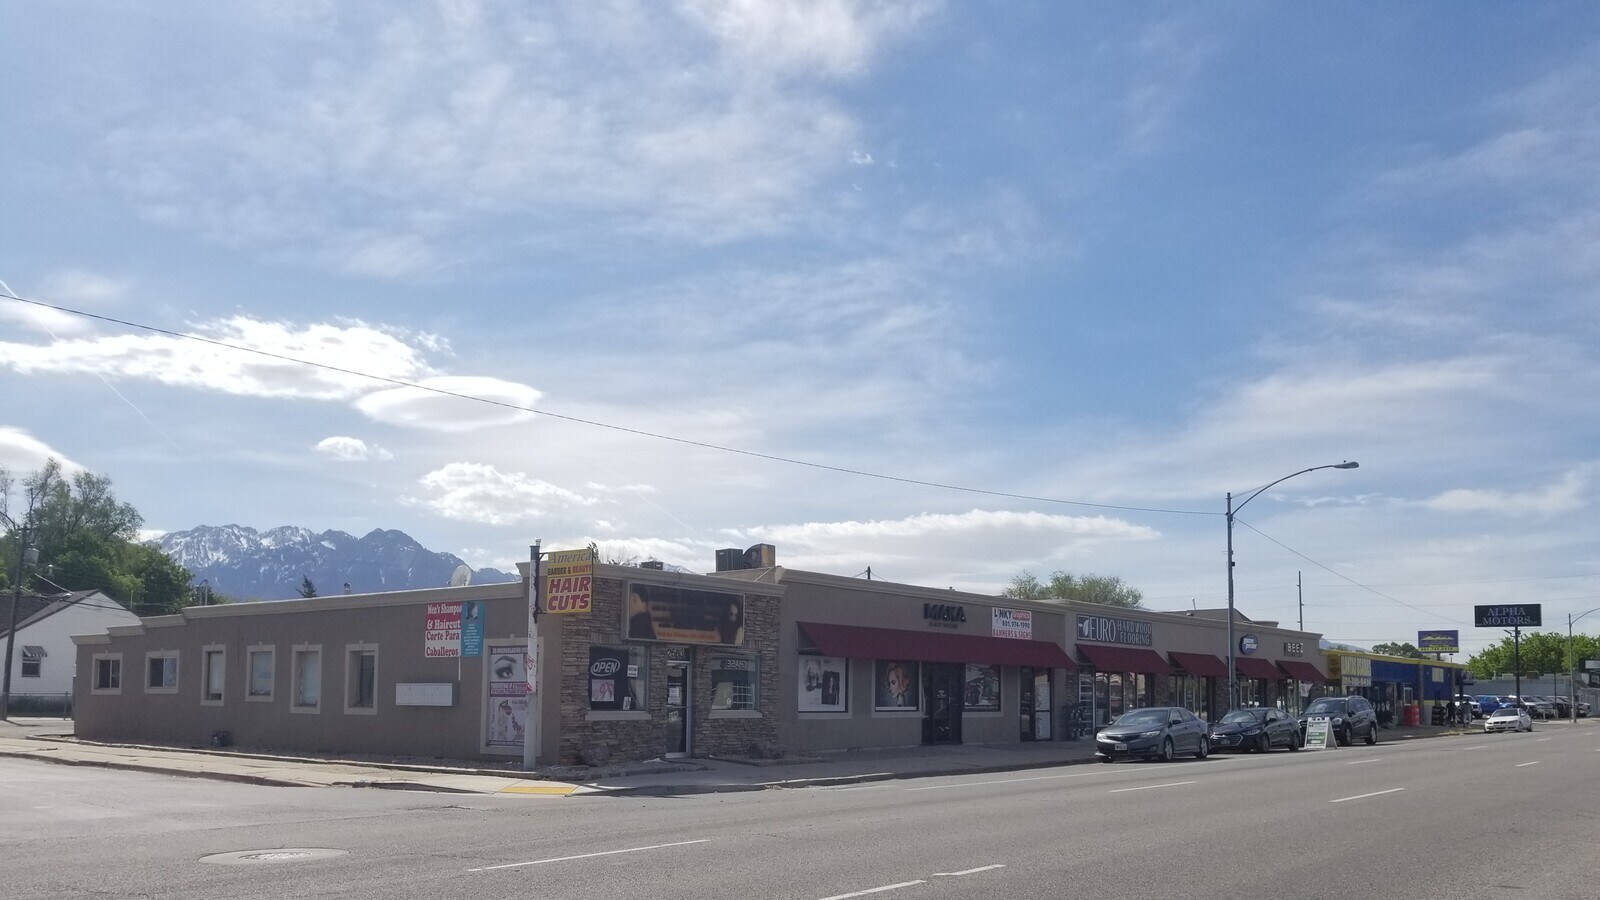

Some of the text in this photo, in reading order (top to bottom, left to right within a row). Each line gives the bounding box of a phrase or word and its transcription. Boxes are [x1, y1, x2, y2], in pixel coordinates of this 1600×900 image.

[548, 566, 567, 575] BARBER
[572, 564, 591, 573] BEAUTY
[549, 577, 591, 593] HAIR
[548, 594, 590, 610] CUTS
[427, 603, 462, 615] Men's Shampoo
[1488, 607, 1526, 616] ALPHA
[434, 620, 461, 629] Haircut
[1483, 616, 1531, 625] MOTORS
[992, 629, 1013, 638] BANNERS
[1018, 631, 1031, 640] SIGNS
[1090, 617, 1152, 641] EURO HARDWOOD
[426, 631, 460, 640] Corte Para
[1120, 632, 1150, 644] FLOORING
[426, 647, 459, 656] Caballeros
[1287, 642, 1304, 653] BEEZ
[592, 661, 617, 673] OPEN
